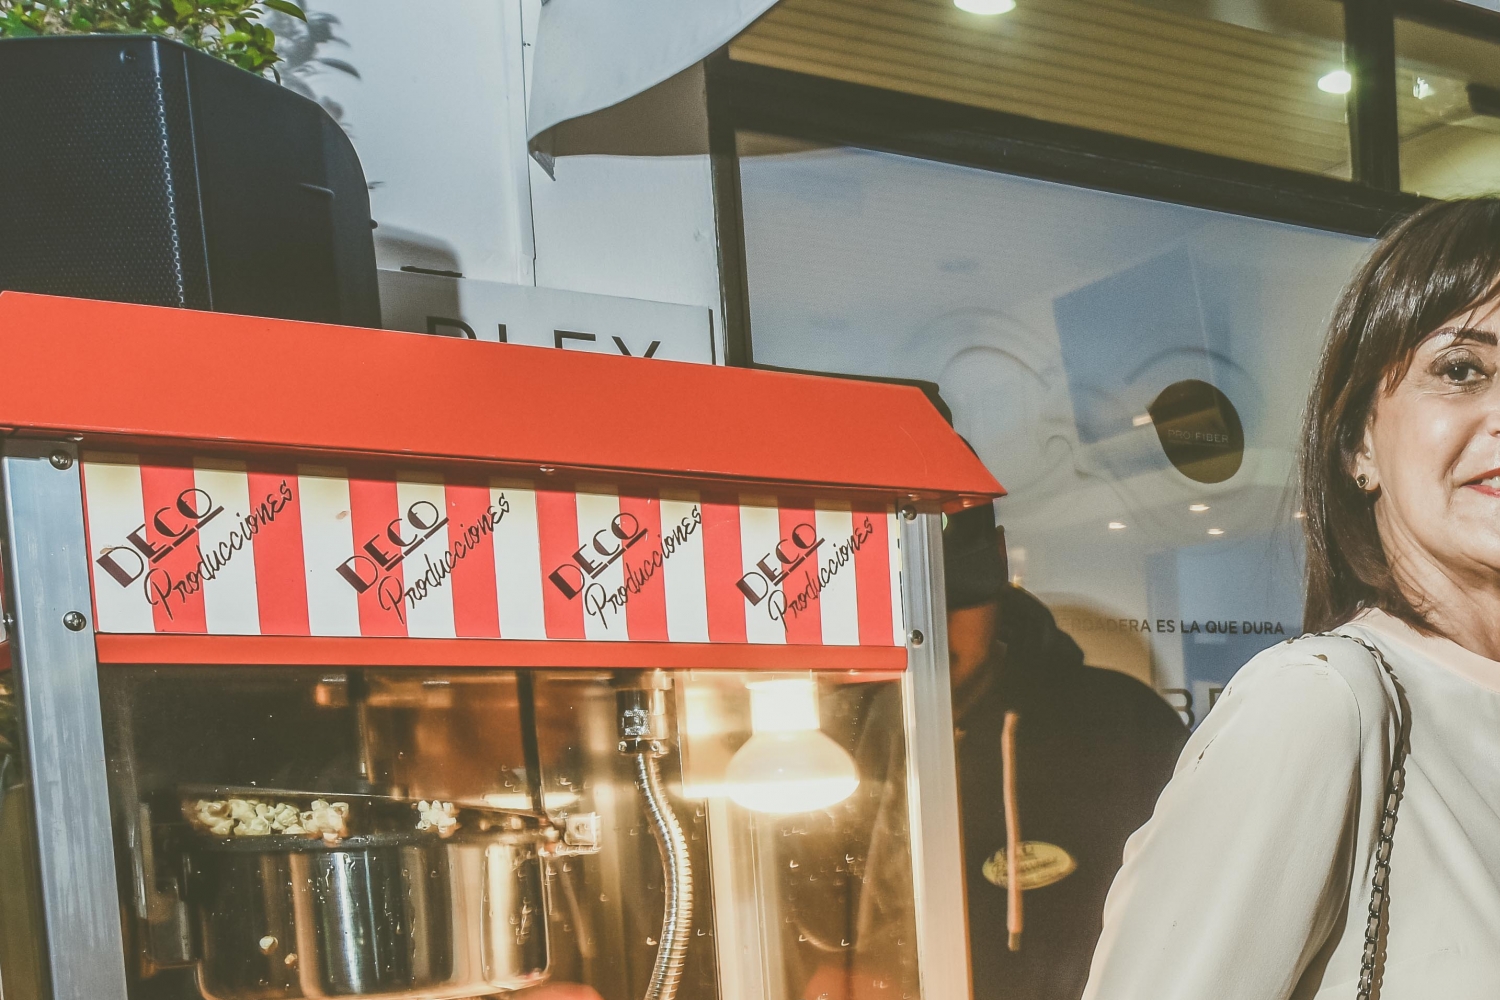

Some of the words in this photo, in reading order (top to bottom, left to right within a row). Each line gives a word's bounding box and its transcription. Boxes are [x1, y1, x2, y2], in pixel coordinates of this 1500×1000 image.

[95, 487, 213, 589] DECO
[335, 500, 440, 595] DECO
[547, 511, 640, 601] DECO
[734, 522, 818, 607] DECO
[1156, 618, 1176, 634] ES
[1180, 619, 1202, 634] LA
[1205, 619, 1239, 635] QUE
[1242, 620, 1285, 636] DURA
